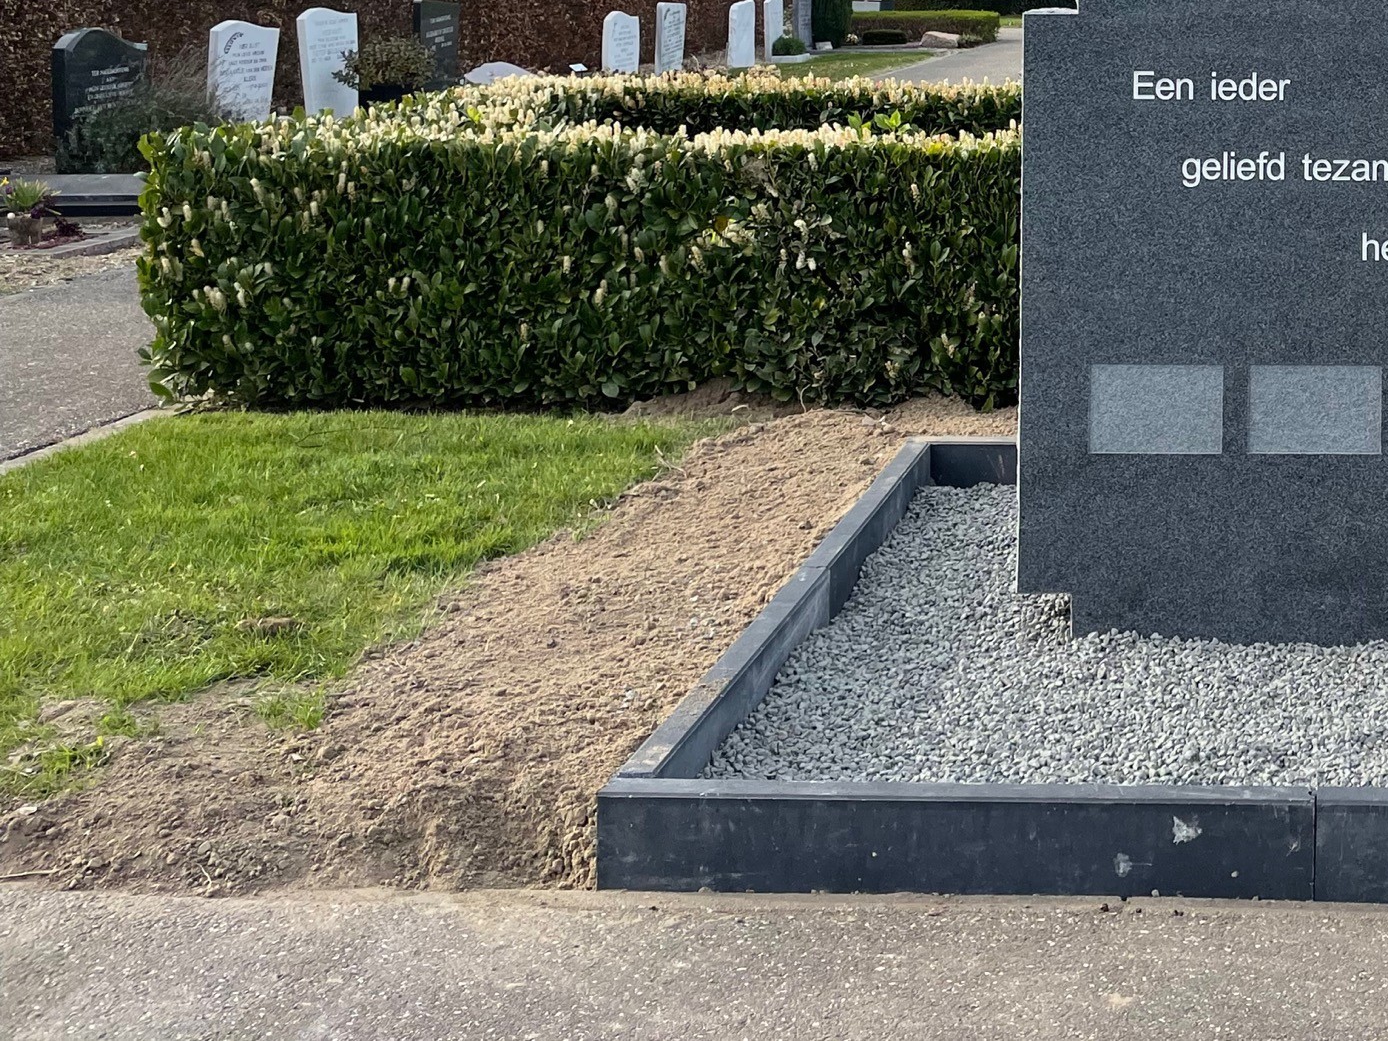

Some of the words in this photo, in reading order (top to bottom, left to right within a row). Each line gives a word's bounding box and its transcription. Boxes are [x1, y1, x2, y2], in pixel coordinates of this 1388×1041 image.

[1133, 71, 1194, 100] Een
[1210, 71, 1291, 101] ieder
[1181, 152, 1285, 188] geliefd
